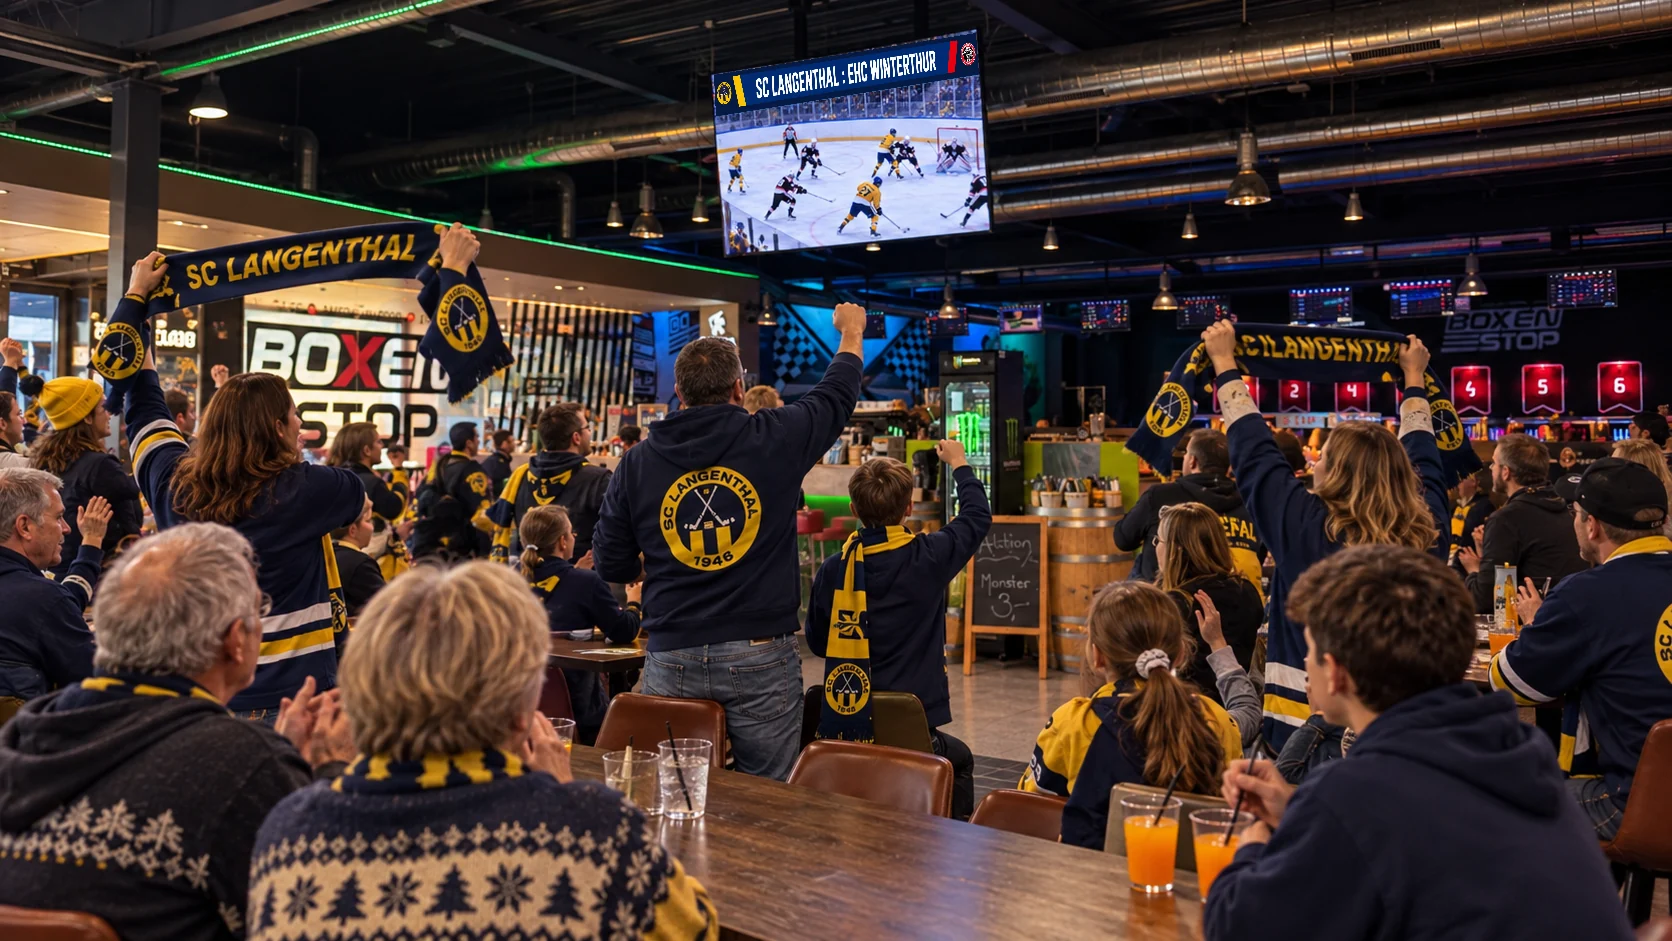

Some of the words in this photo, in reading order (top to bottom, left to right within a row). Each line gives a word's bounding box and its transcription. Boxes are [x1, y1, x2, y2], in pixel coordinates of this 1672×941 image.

[755, 77, 770, 99] SC
[771, 65, 840, 97] LANGENTHAL
[847, 60, 868, 85] EHC
[869, 50, 937, 81] WINTERTHUR
[186, 260, 220, 290] SC
[227, 233, 417, 282] LANGENTHAL
[1448, 309, 1562, 332] BOXEN
[1480, 331, 1561, 351] STOP
[1289, 383, 1299, 398] 2
[1346, 384, 1357, 398] 4
[1537, 378, 1549, 395] 5
[1613, 377, 1626, 394] 6
[668, 469, 758, 520] LANGENTHAL
[663, 506, 674, 531] SC
[693, 550, 734, 567] 1946
[981, 573, 1031, 597] Monster
